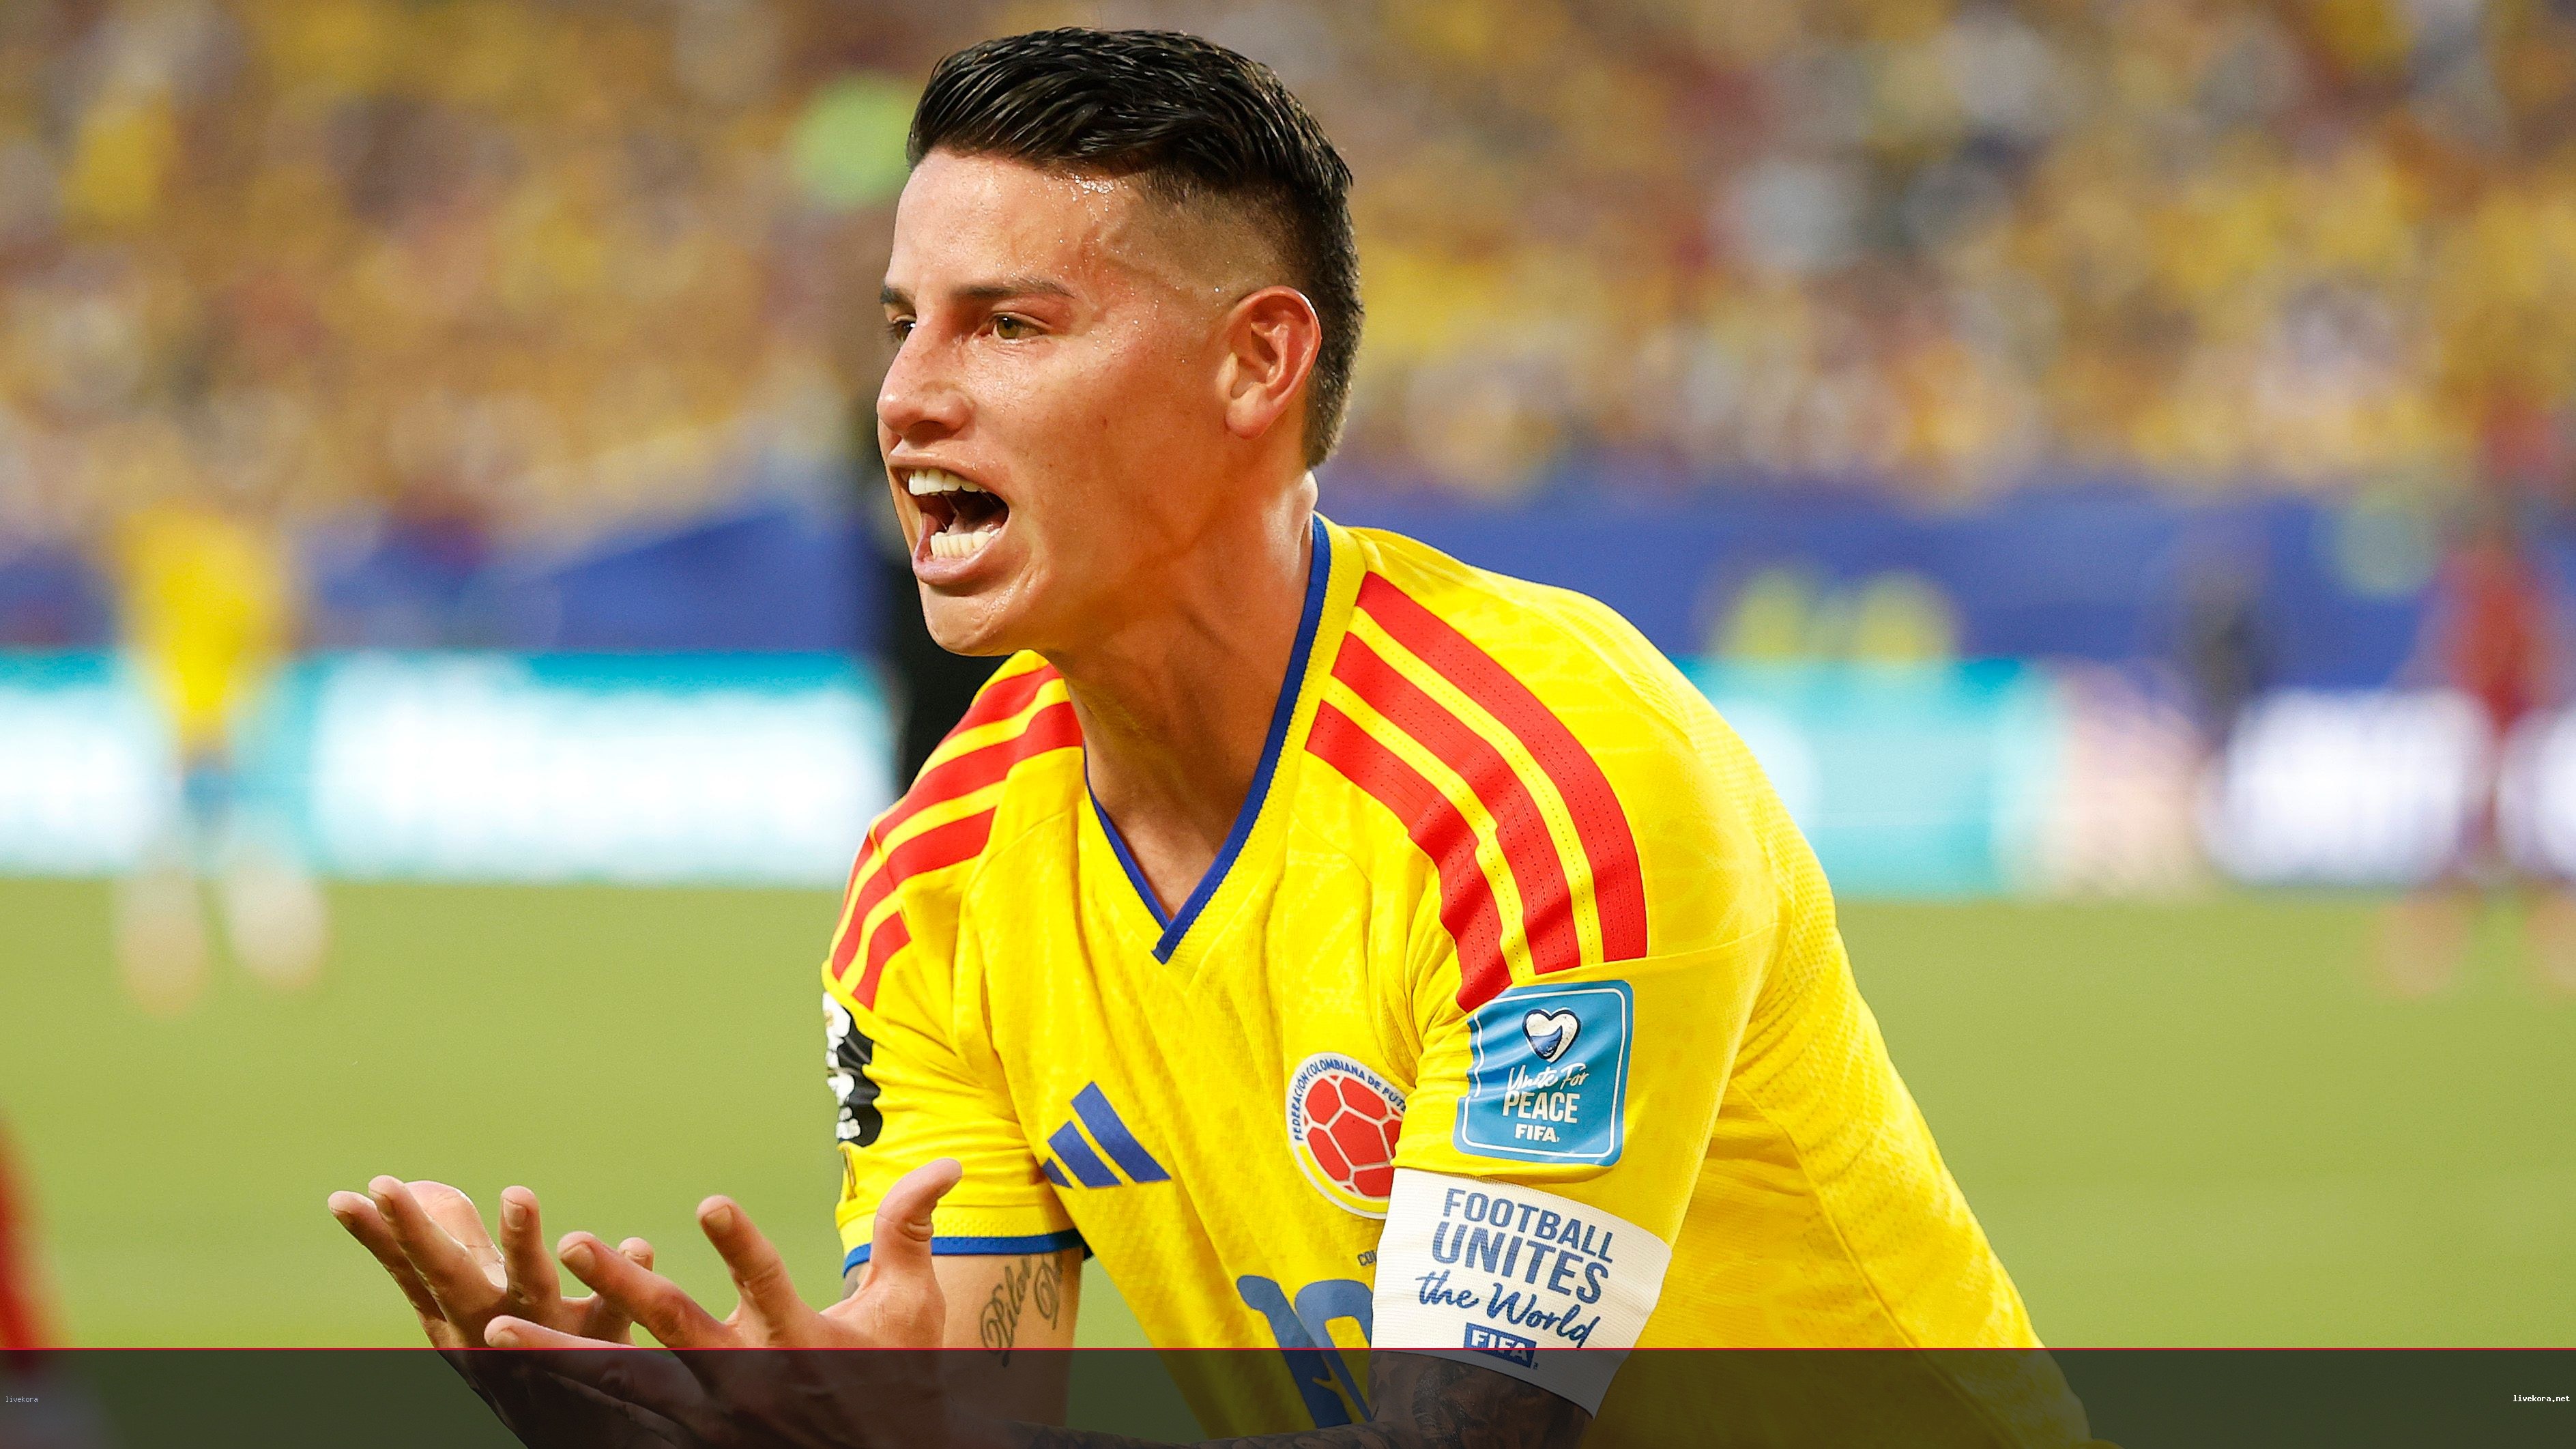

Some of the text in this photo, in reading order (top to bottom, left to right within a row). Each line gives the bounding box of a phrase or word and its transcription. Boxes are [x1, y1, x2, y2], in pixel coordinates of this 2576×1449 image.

[1307, 1059, 1365, 1080] COLOMBIANA
[1367, 1075, 1382, 1091] DE
[1507, 1063, 1589, 1092] Unite For
[1503, 1090, 1580, 1124] PEACE
[1514, 1123, 1559, 1143] FIFA
[1443, 1188, 1614, 1264] FOOTBALL
[1432, 1220, 1609, 1304] UNITES
[1415, 1269, 1601, 1350] the World
[1471, 1329, 1528, 1362] FIFA
